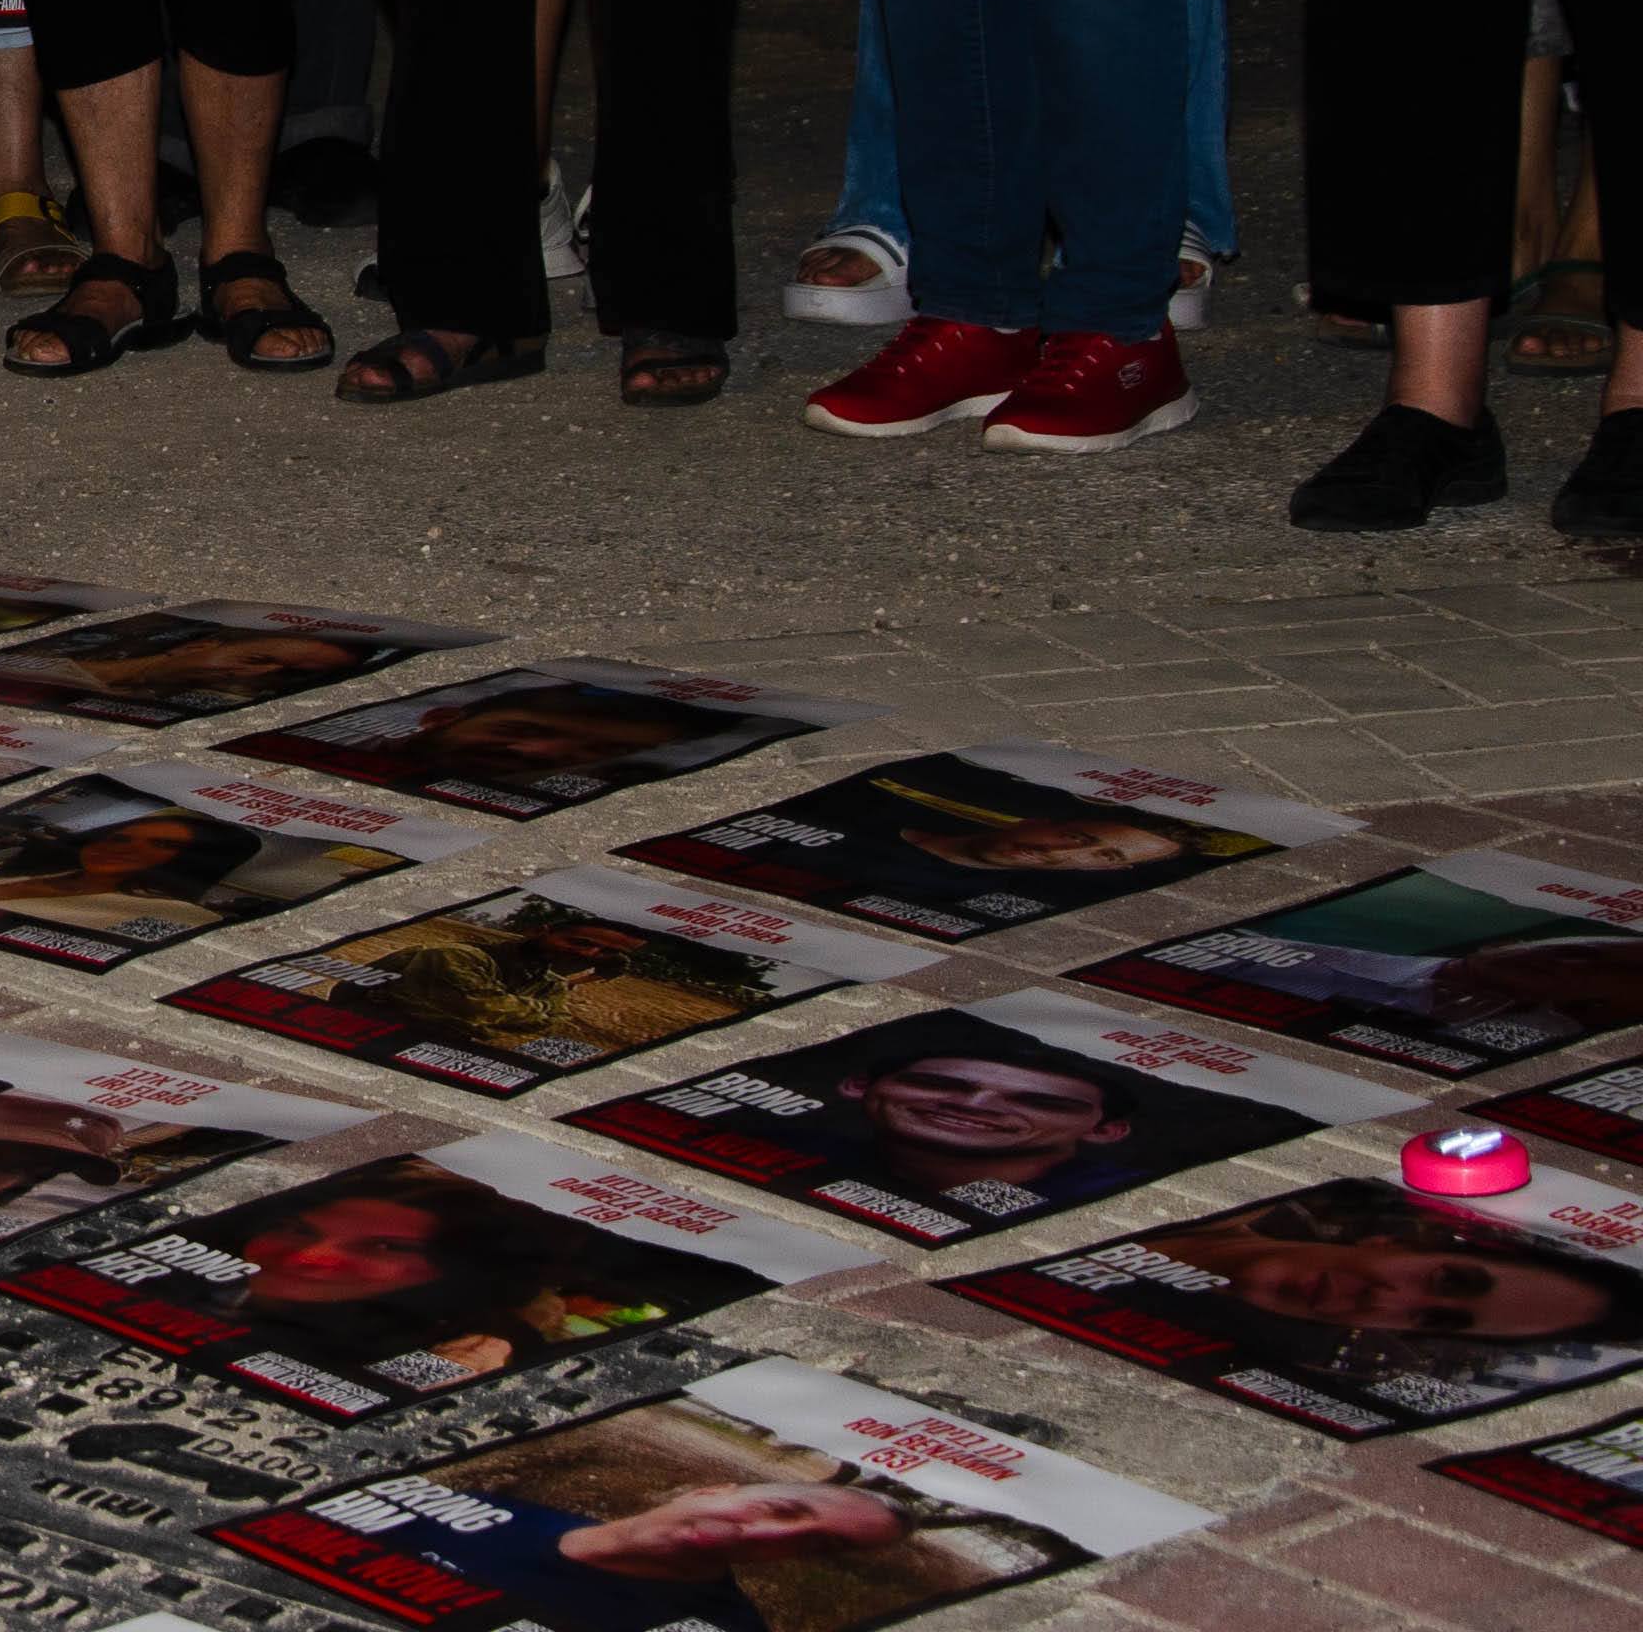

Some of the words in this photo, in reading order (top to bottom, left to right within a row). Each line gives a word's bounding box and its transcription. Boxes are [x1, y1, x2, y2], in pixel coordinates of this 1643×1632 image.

[192, 785, 234, 803] AMIT
[689, 824, 770, 851] HIM
[733, 812, 845, 848] BRING
[645, 902, 722, 931] NIMROD
[717, 917, 793, 946] COHEN
[237, 963, 315, 991] HIM
[287, 956, 402, 990] BRING
[1100, 1030, 1169, 1058] DOLEV
[1172, 1047, 1250, 1076] YAHUD
[84, 1074, 133, 1095] LIRI
[128, 1079, 201, 1107] ELBAG
[643, 1087, 744, 1119] HIM
[691, 1072, 827, 1118] BRING
[547, 1177, 635, 1210] DANIELA
[633, 1201, 720, 1235] GILBOA
[76, 1249, 170, 1287] HER
[131, 1233, 262, 1283] BRING
[1032, 1257, 1140, 1291] HER
[1088, 1241, 1232, 1293] BRING
[193, 1438, 321, 1482] D400
[843, 1416, 902, 1447] RON
[897, 1427, 1024, 1484] BENJAMIN
[861, 1447, 924, 1475] (53)
[304, 1486, 421, 1536] HIM
[364, 1473, 516, 1535] BRING
